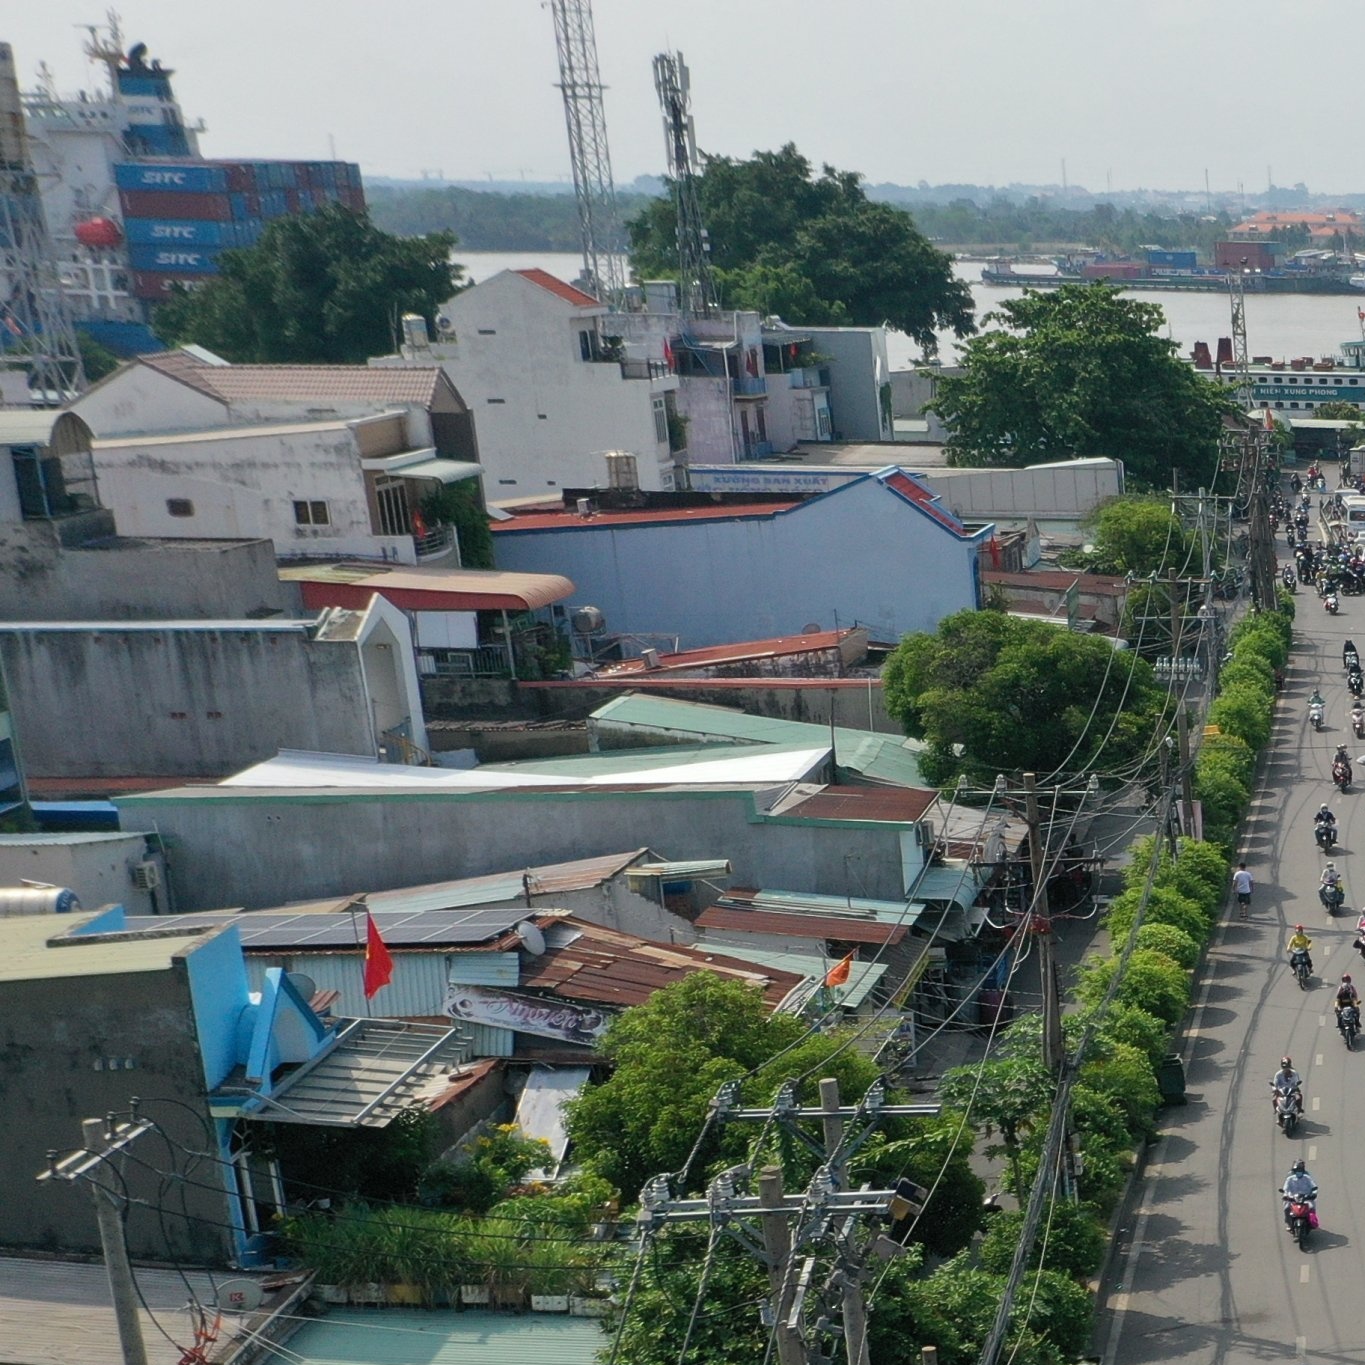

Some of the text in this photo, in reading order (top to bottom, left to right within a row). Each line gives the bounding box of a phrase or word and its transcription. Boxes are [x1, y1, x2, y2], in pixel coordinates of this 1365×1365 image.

[141, 172, 186, 184] SITC
[151, 226, 196, 238] SITC
[156, 253, 201, 265] SITC
[1309, 388, 1338, 396] PHONG
